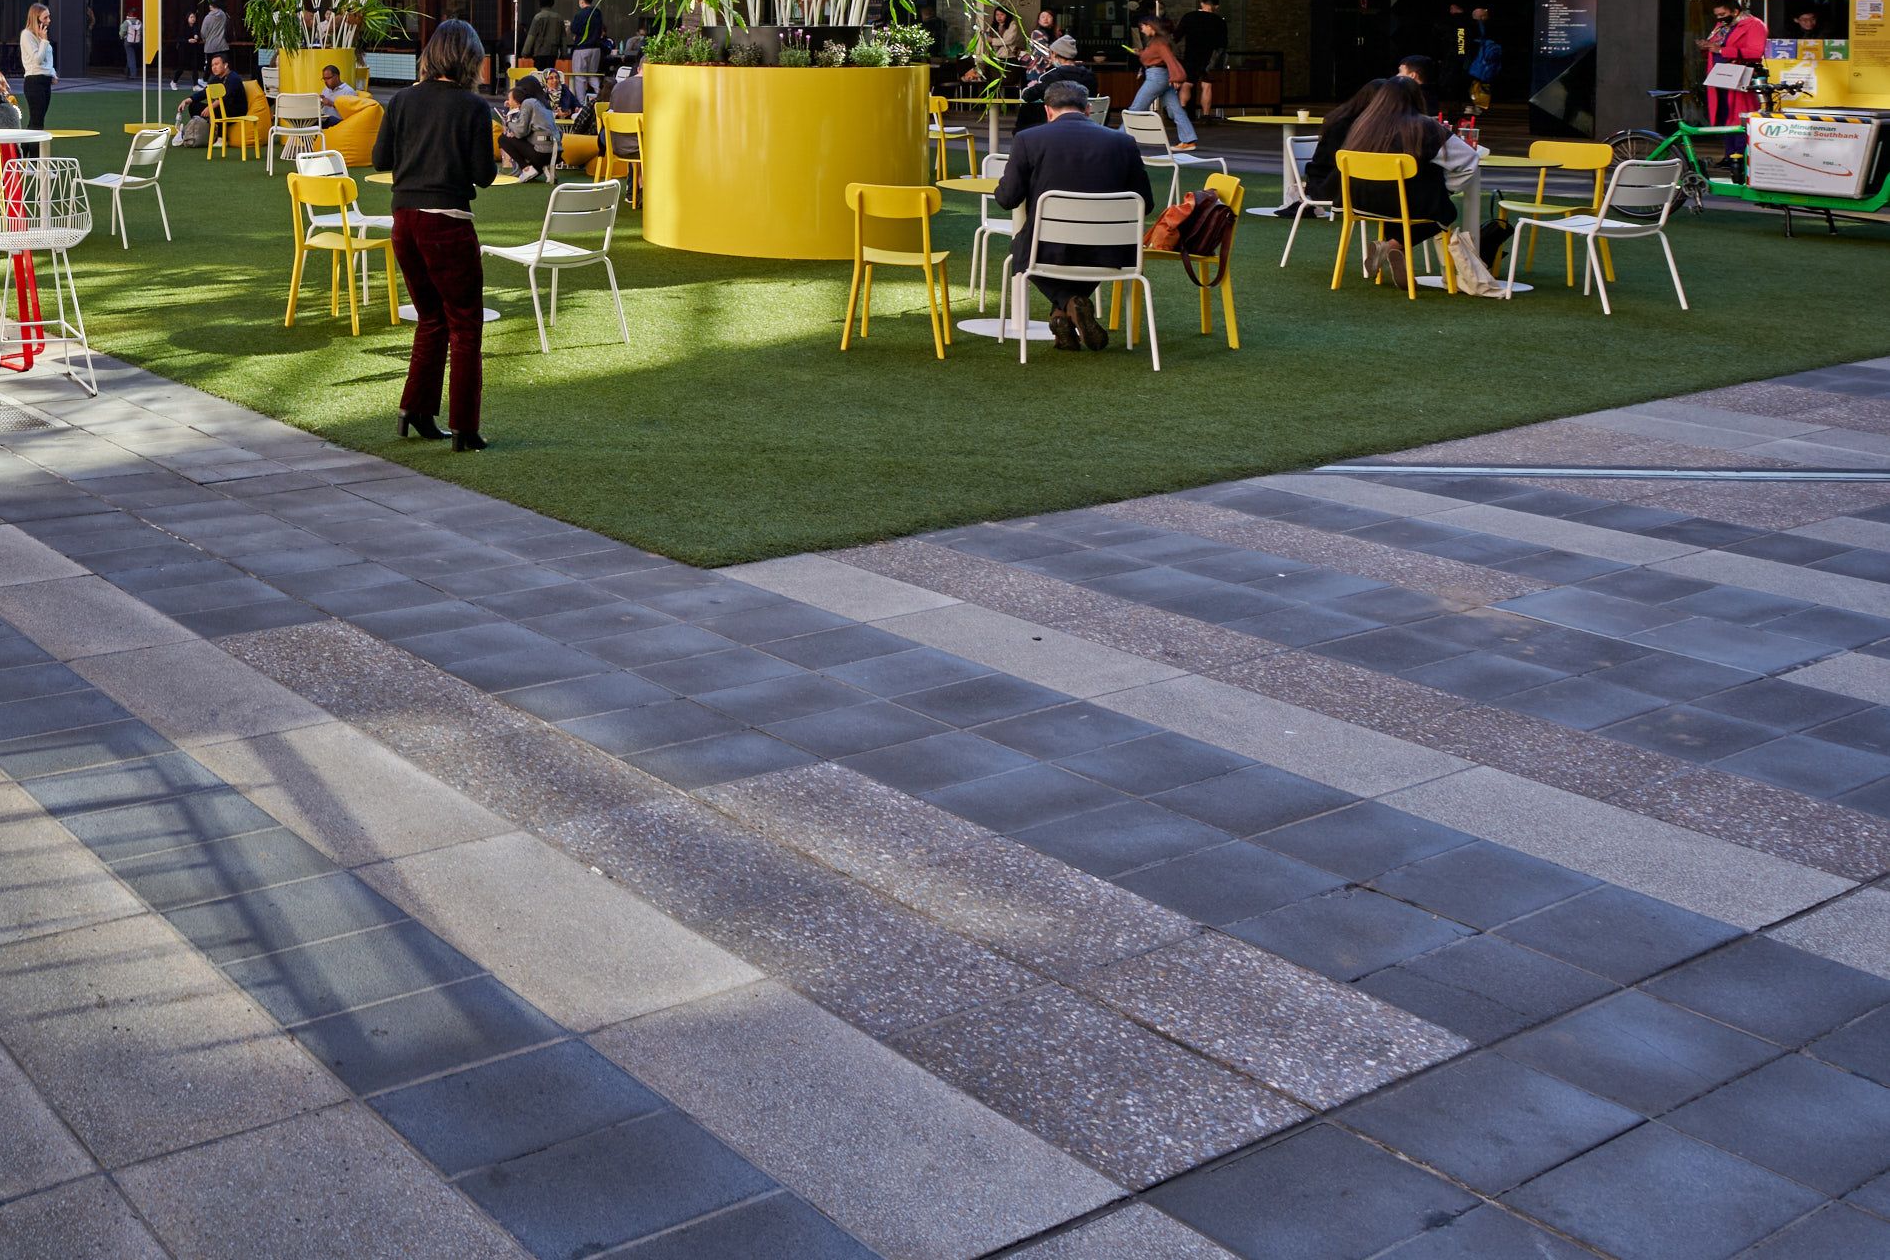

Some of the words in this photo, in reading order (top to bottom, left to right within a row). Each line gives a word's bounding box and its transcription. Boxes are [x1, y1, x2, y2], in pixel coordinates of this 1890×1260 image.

[1790, 123, 1837, 133] Minuteman
[1788, 129, 1812, 137] Press
[1813, 130, 1860, 140] Southbank
